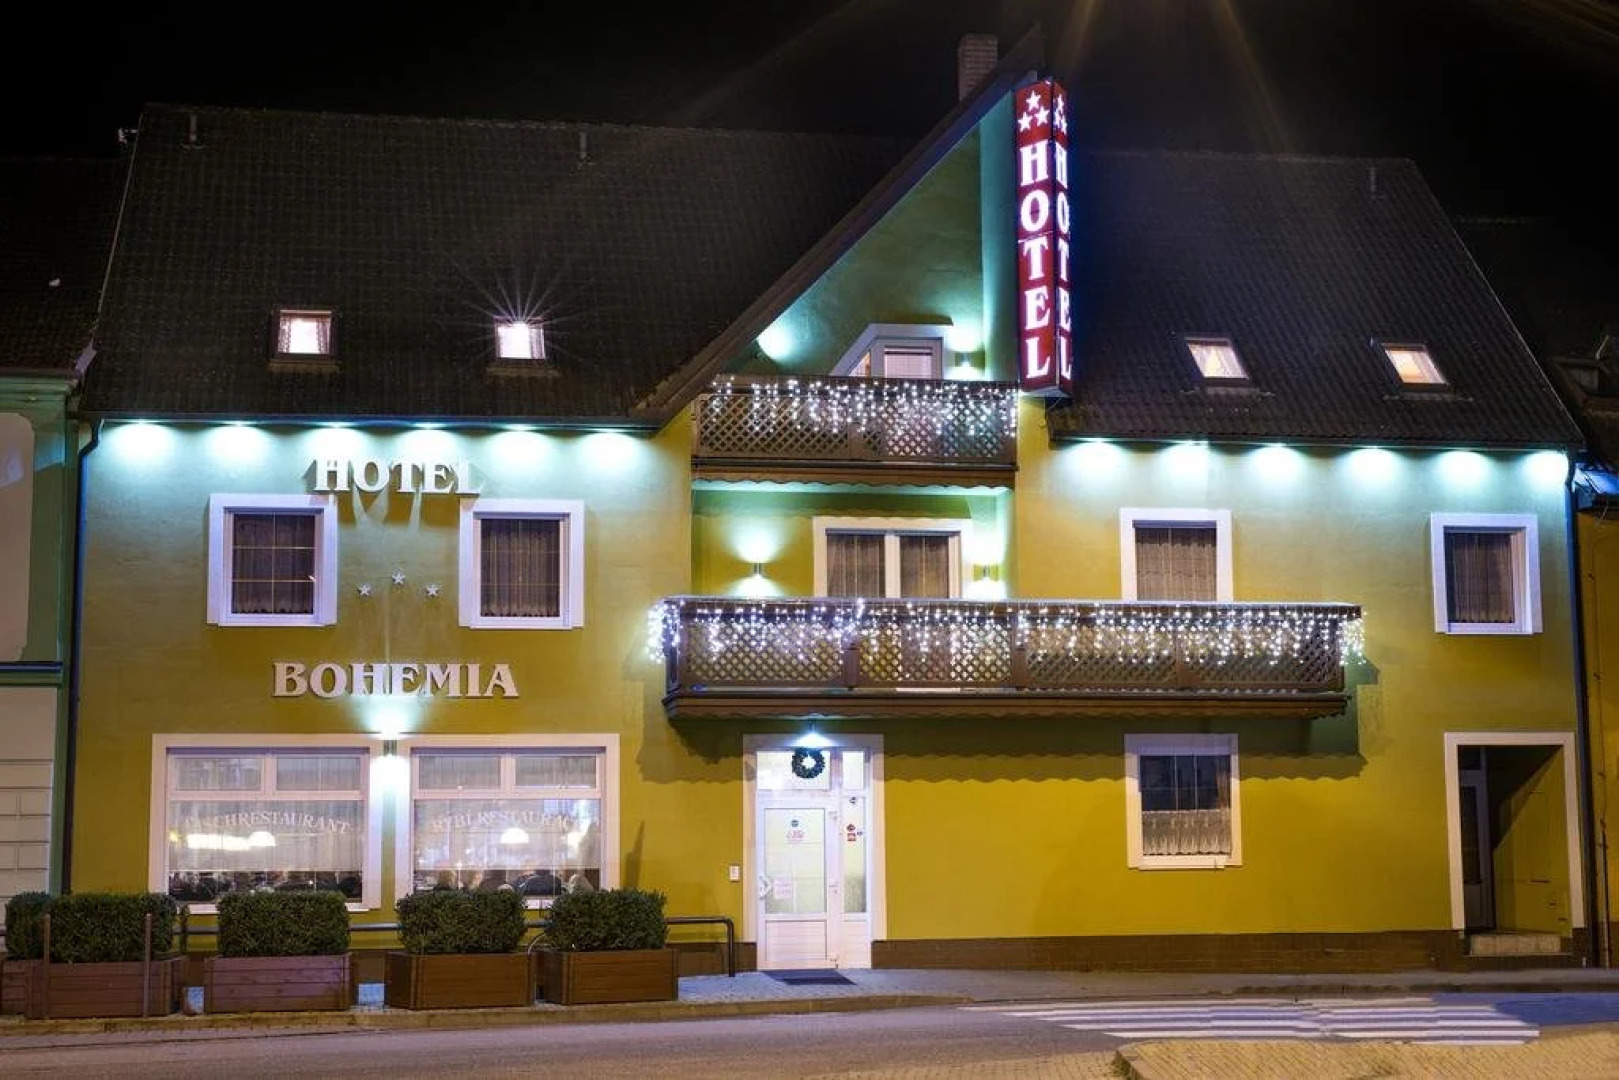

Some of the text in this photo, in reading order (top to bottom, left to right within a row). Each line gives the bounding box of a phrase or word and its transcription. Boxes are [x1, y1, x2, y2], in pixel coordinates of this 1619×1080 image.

[1019, 138, 1051, 380] HOTEL
[1054, 140, 1072, 381] HOTEL
[313, 457, 483, 495] HOTEL
[271, 661, 519, 698] BOHEMIA
